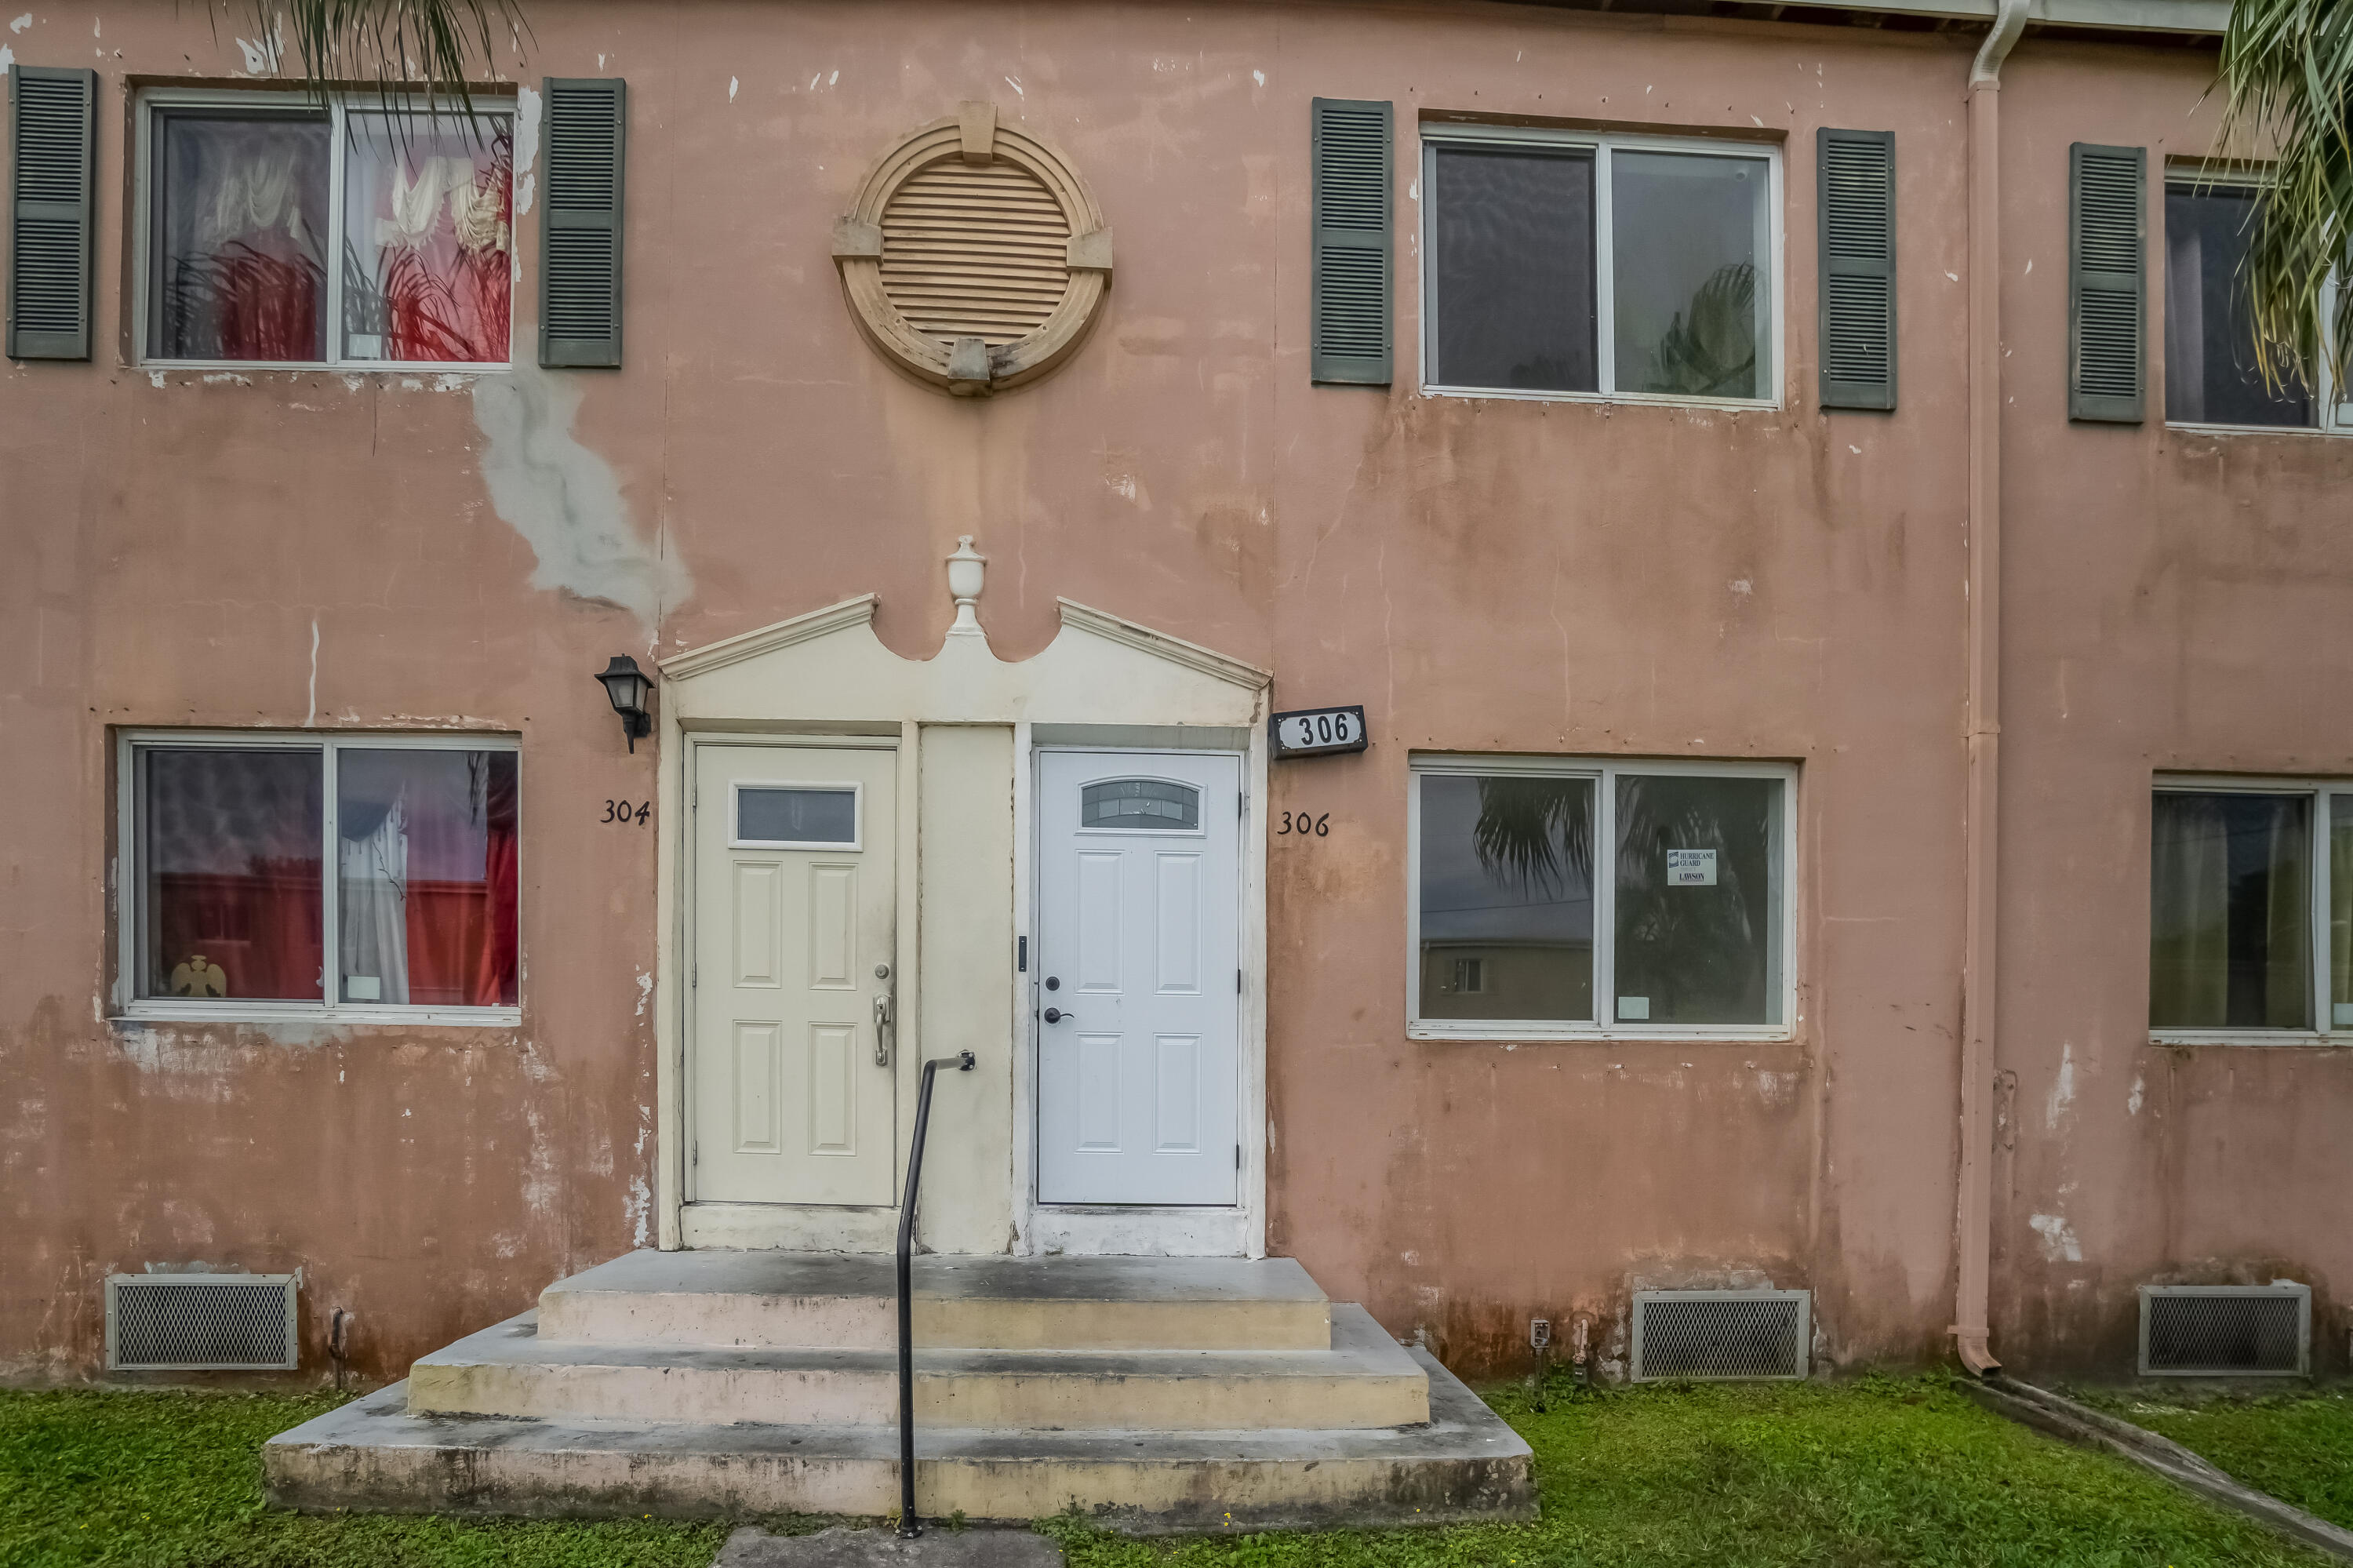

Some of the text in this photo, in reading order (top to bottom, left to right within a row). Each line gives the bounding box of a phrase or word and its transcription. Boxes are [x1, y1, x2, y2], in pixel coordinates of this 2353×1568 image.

[1298, 713, 1348, 745] 306
[600, 799, 650, 826] 304
[1277, 811, 1329, 837] 306
